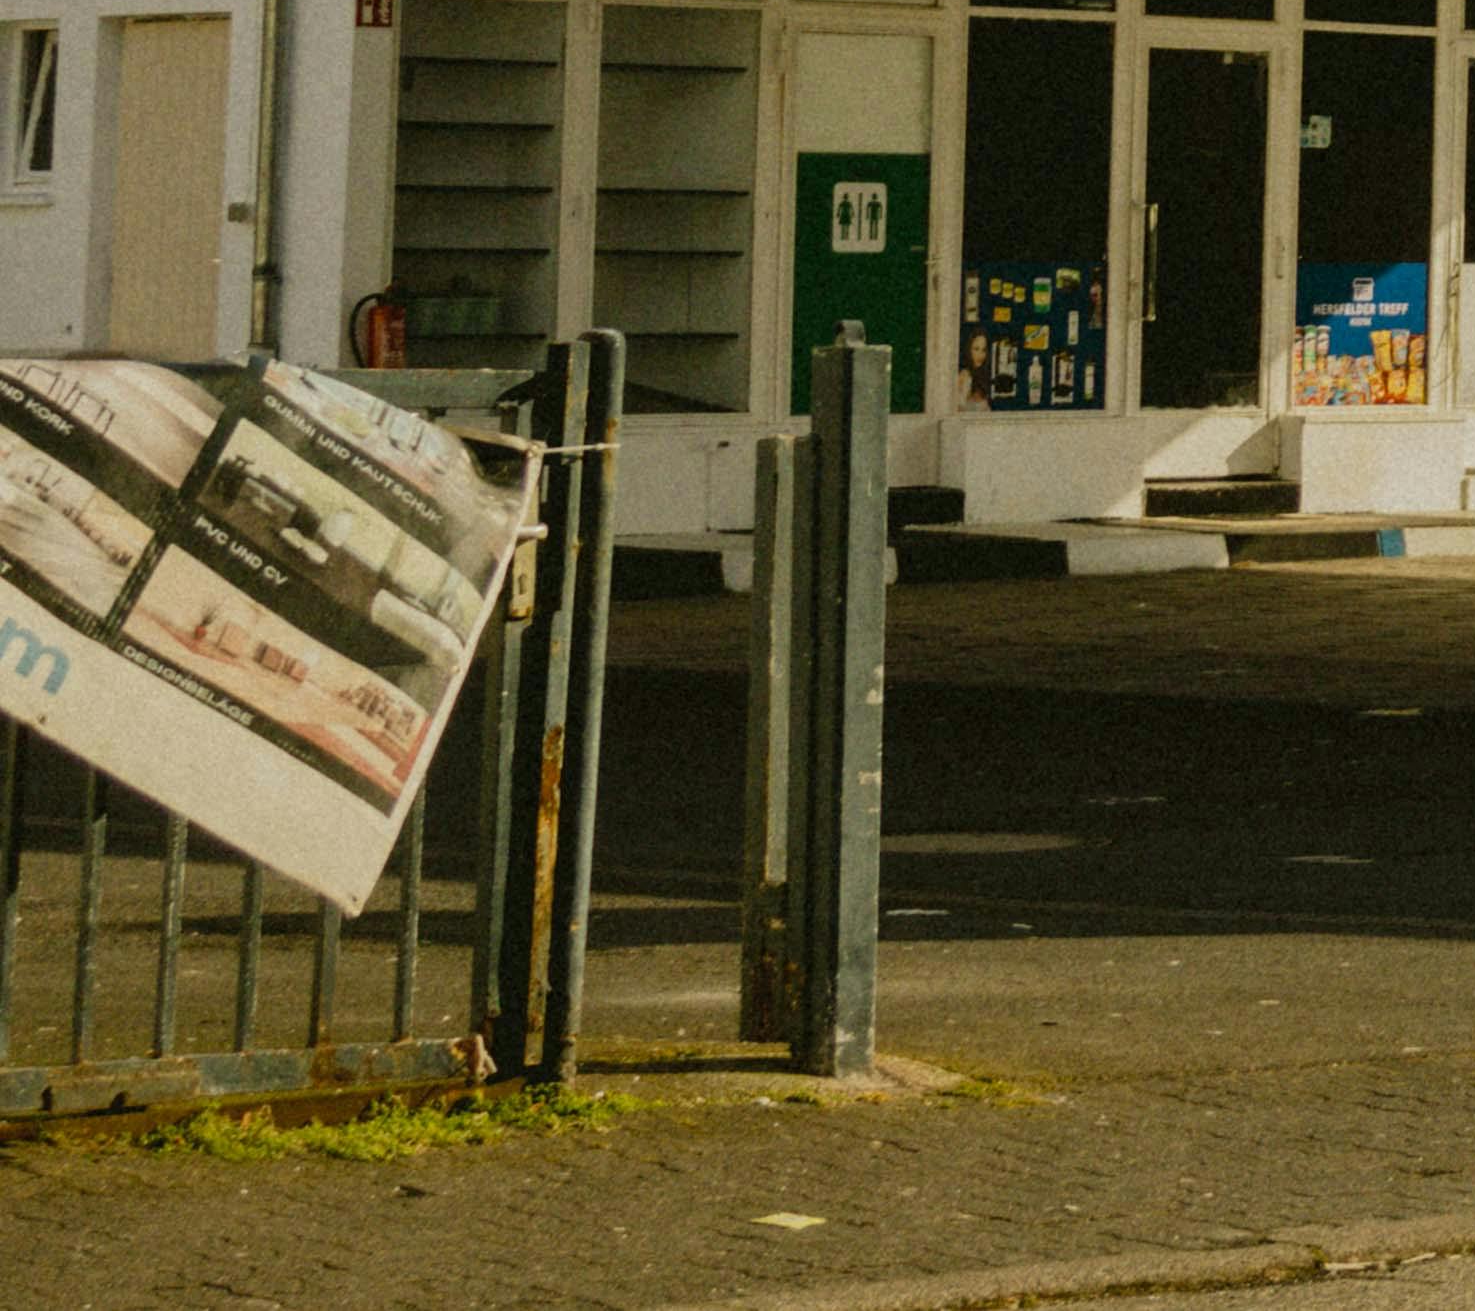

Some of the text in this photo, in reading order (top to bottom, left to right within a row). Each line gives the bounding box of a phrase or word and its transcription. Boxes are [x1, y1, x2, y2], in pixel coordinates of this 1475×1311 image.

[25, 397, 75, 436] KORK
[263, 394, 443, 525] GUMMI UND KAUTSCHUK
[194, 513, 289, 586] PVC UND CV
